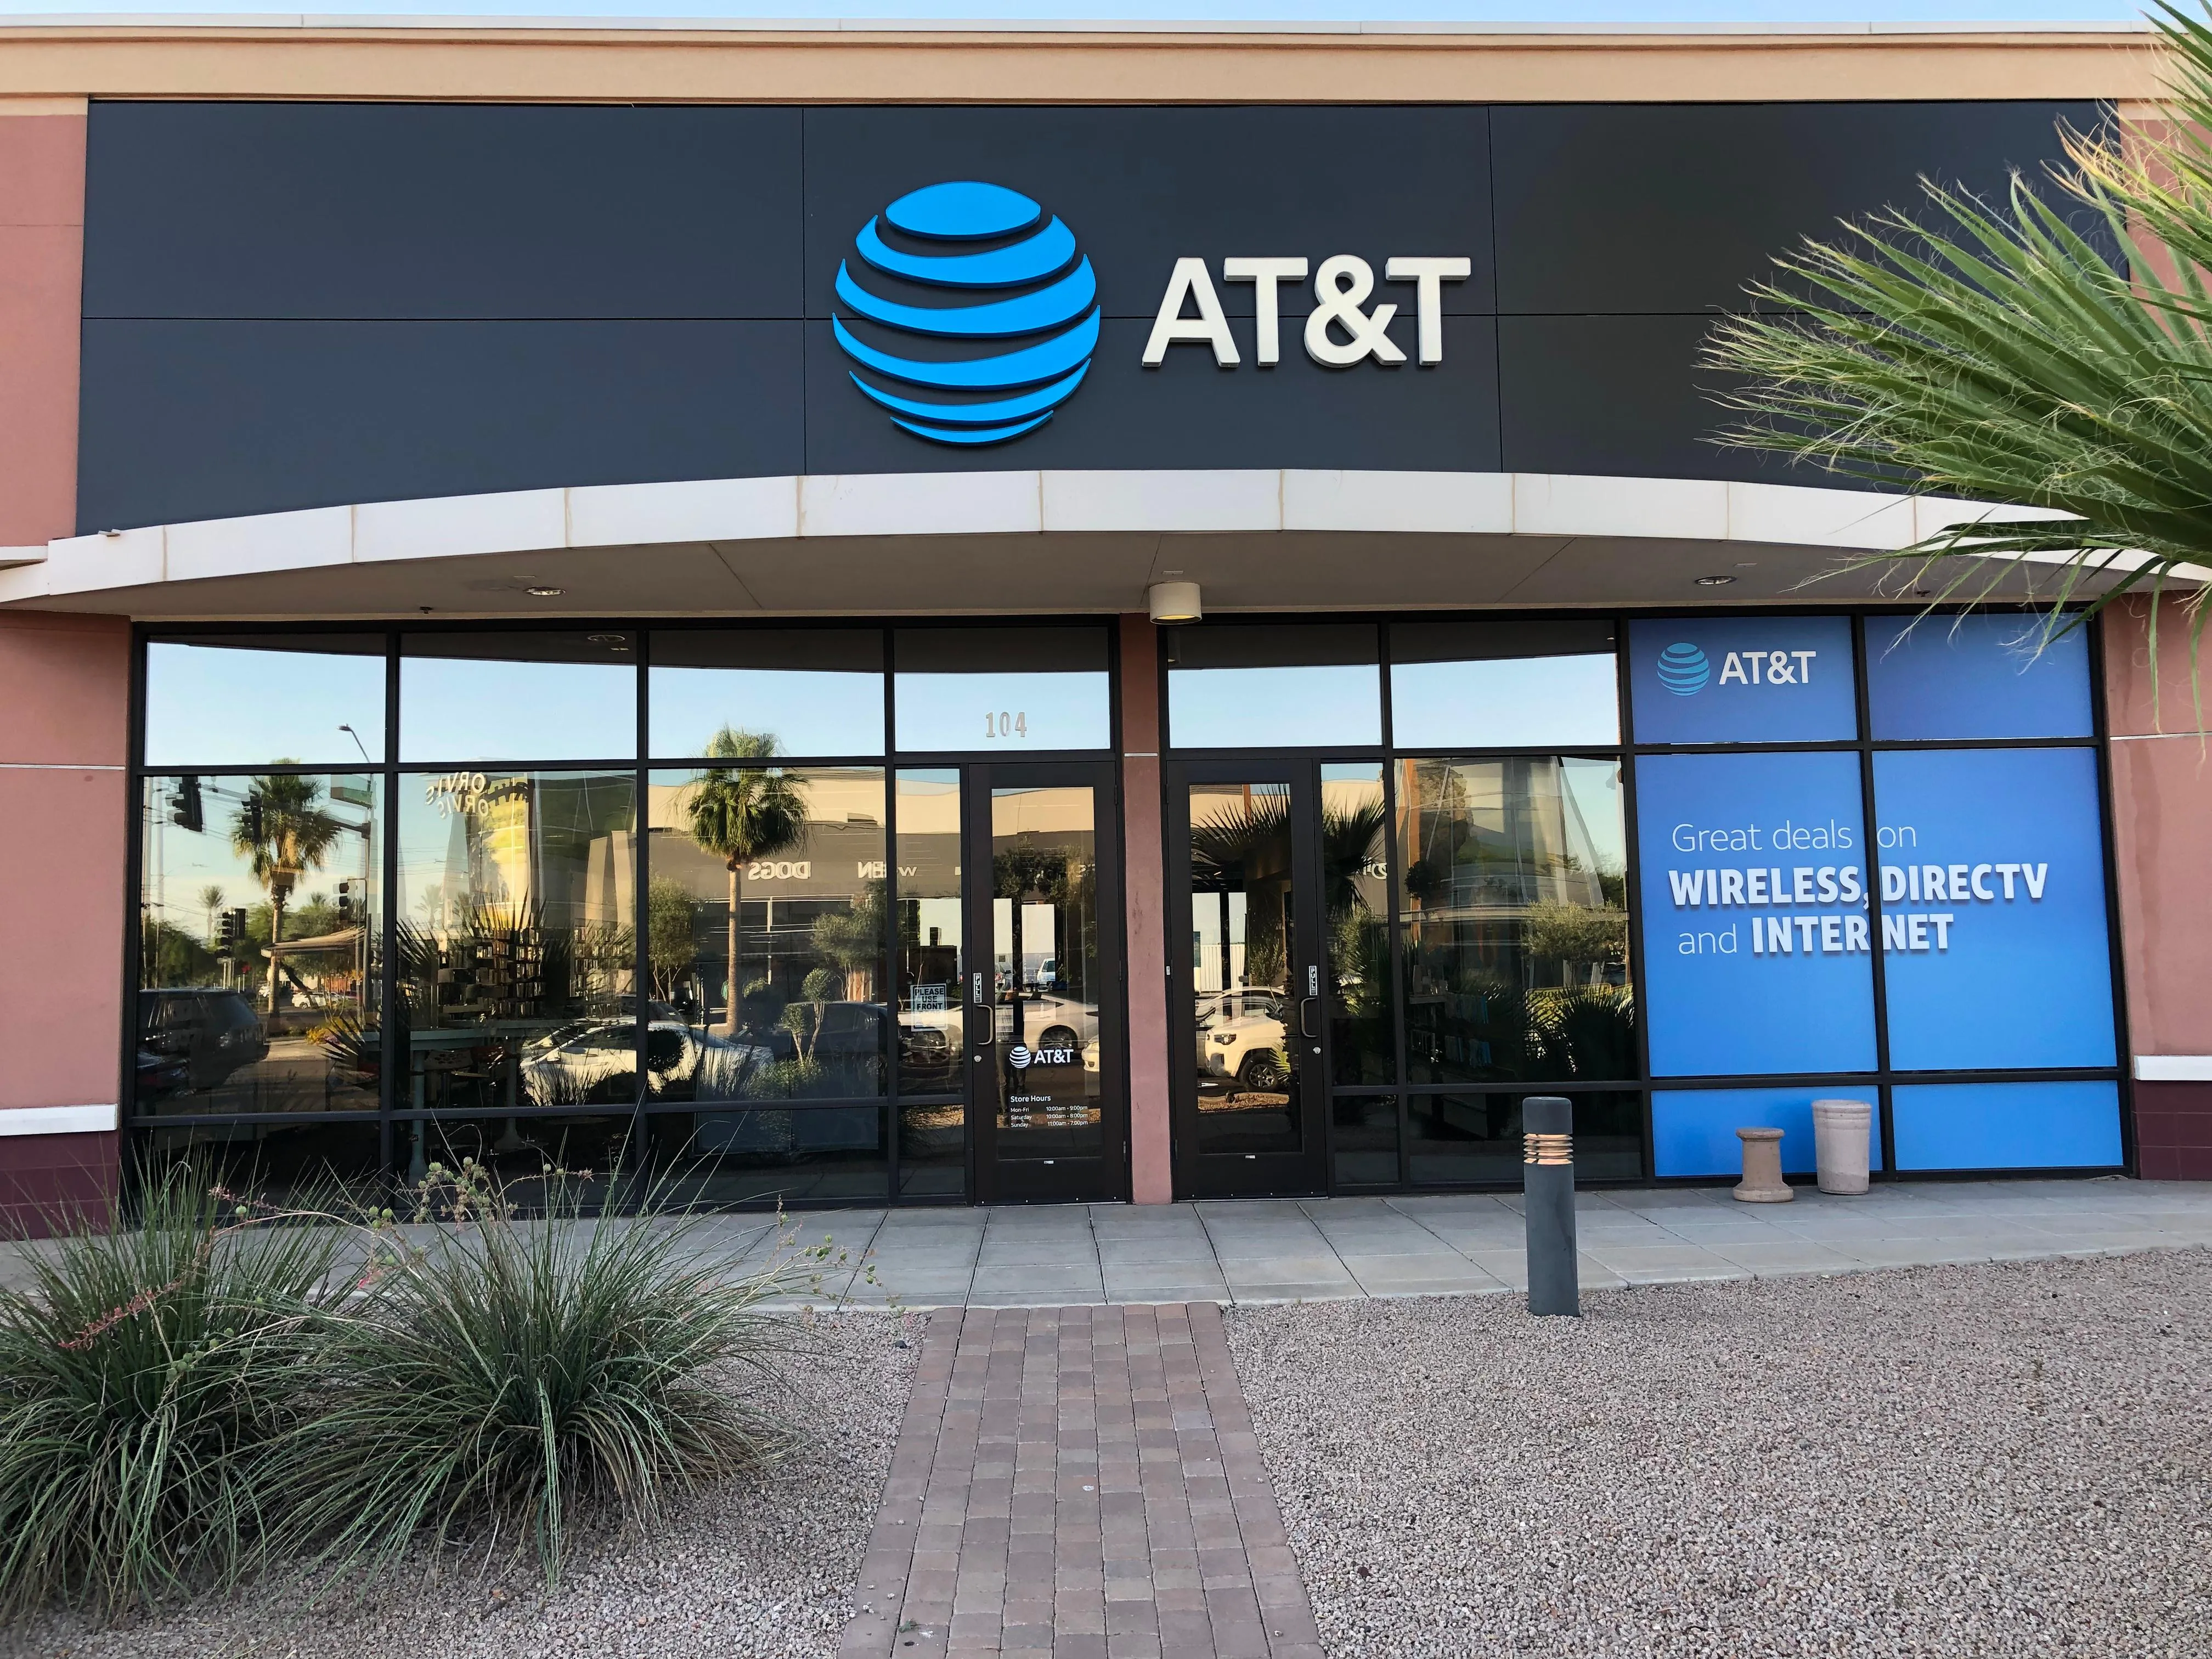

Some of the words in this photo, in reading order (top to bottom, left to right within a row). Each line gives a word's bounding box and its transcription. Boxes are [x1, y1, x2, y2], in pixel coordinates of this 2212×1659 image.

[1142, 254, 1471, 368] AT&T
[1719, 651, 1816, 685] AT&T
[986, 712, 1027, 737] 104
[1672, 823, 1762, 852] Great
[1772, 820, 1853, 850] deals
[1877, 825, 1917, 849] on
[1668, 866, 1869, 910] WIRELESS,
[1881, 863, 2048, 901] DIRECTV
[1678, 924, 1737, 955] and
[1752, 913, 1954, 953] INTERNET
[1034, 1049, 1074, 1064] AT&T
